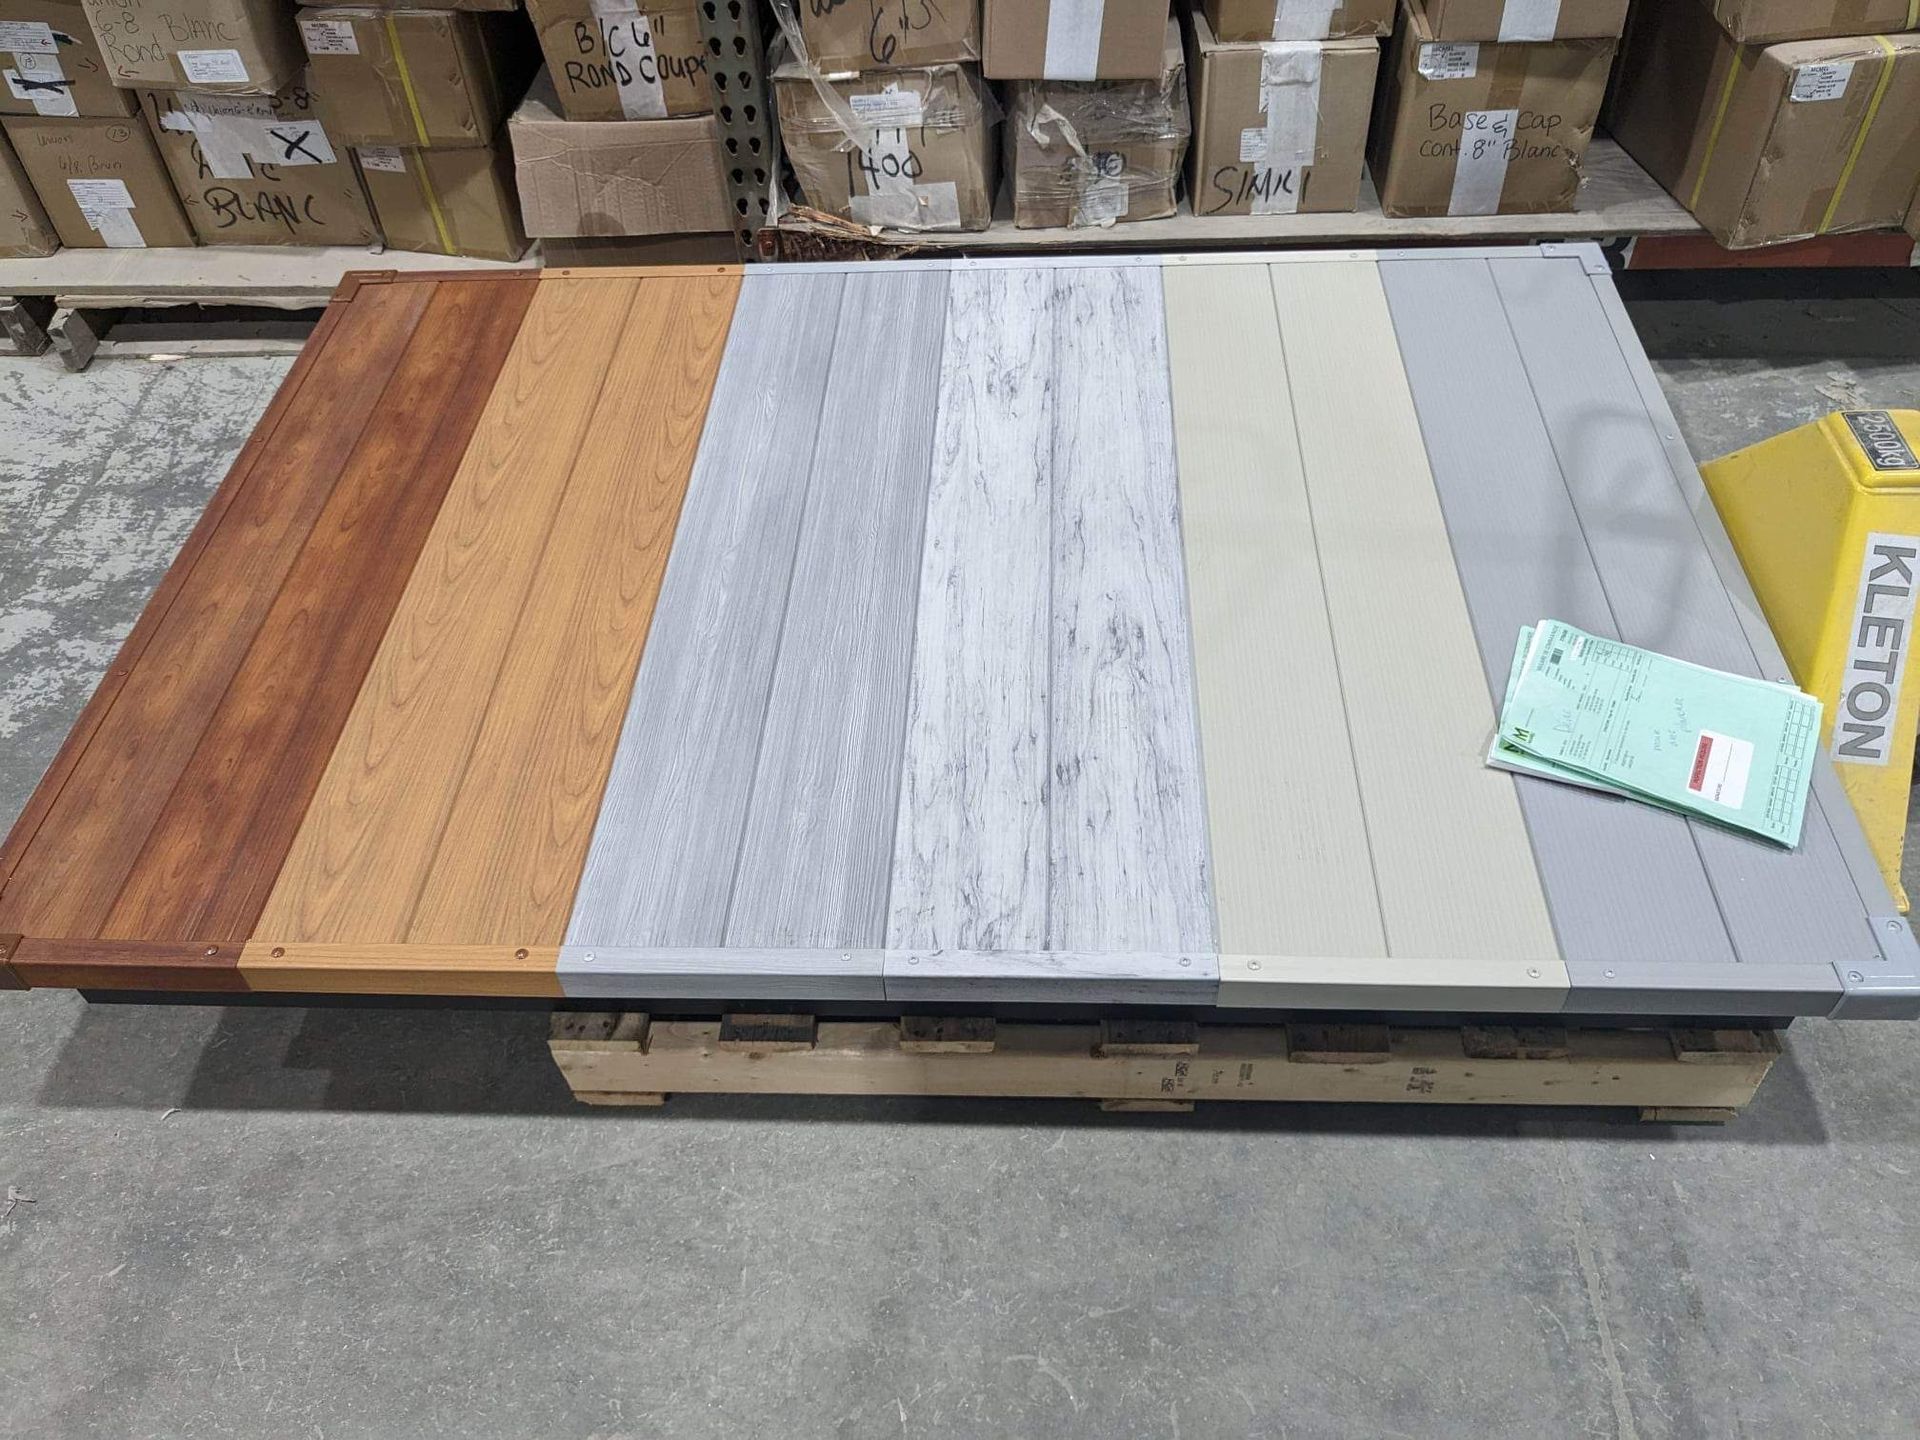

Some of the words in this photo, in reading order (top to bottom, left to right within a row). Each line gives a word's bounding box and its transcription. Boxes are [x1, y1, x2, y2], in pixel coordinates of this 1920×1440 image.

[564, 60, 633, 93] ROND
[1428, 103, 1488, 132] Base
[1502, 137, 1561, 161] Blanc
[1857, 415, 1906, 466] 2500kg
[1838, 544, 1917, 759] KLETON
